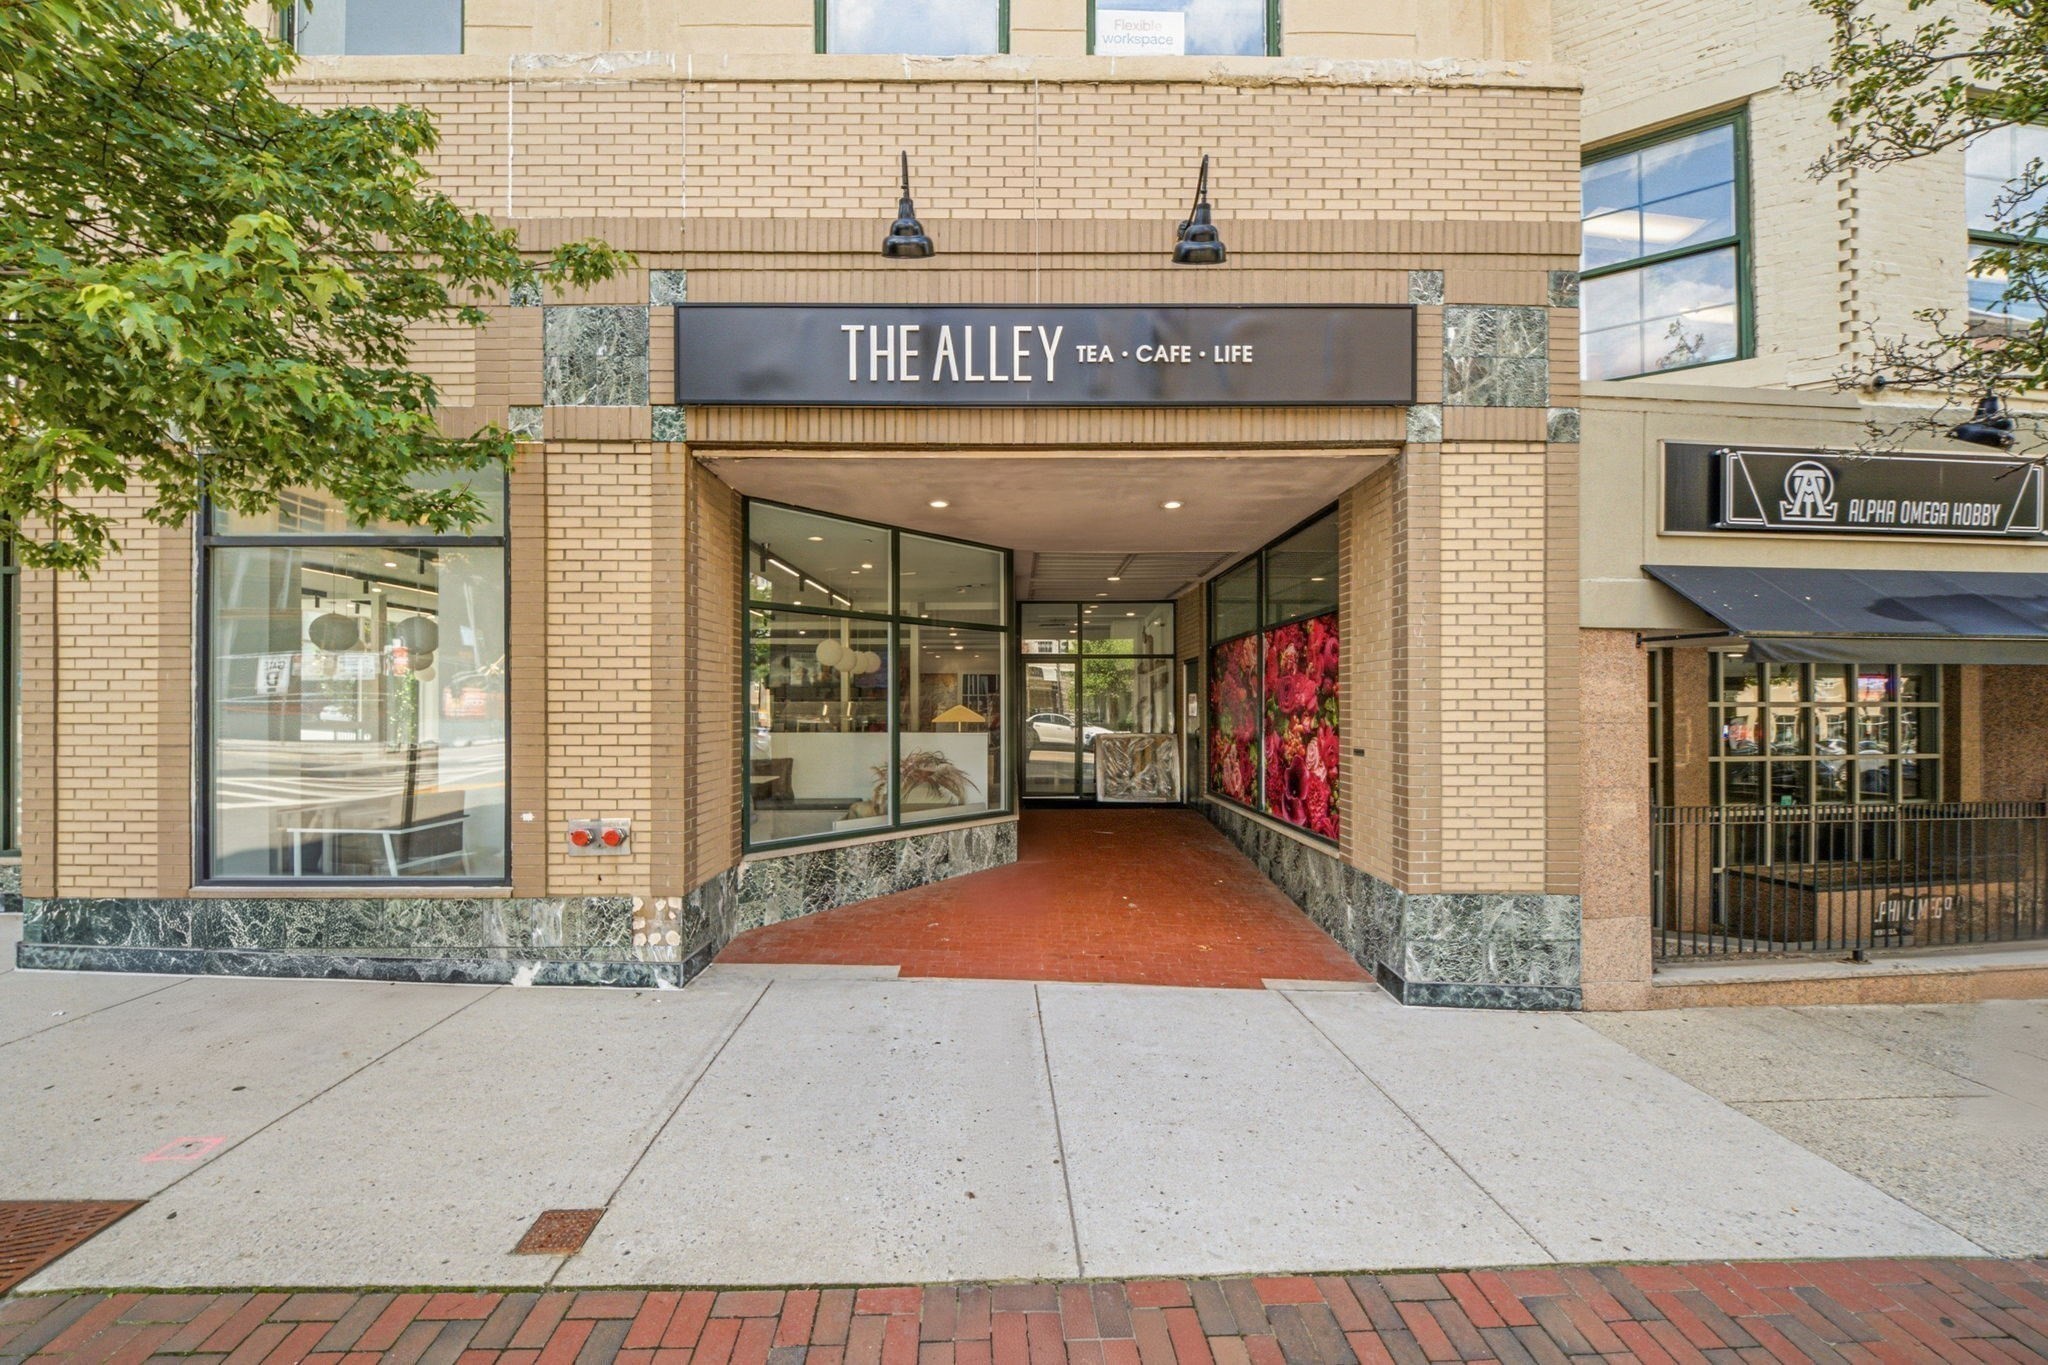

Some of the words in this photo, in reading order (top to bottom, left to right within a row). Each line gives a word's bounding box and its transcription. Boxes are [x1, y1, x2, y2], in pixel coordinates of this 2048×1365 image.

[1114, 19, 1162, 32] Flexible
[1103, 33, 1174, 47] workspace
[841, 324, 920, 382] THE
[932, 324, 1064, 382] ALLEY
[1076, 344, 1114, 363] TEA
[1136, 344, 1192, 364] CAFE
[1213, 344, 1254, 363] LIFE
[1848, 499, 1897, 523] ALPHA
[1899, 500, 1951, 525] OMEGA
[1952, 502, 2002, 527] HOBBY
